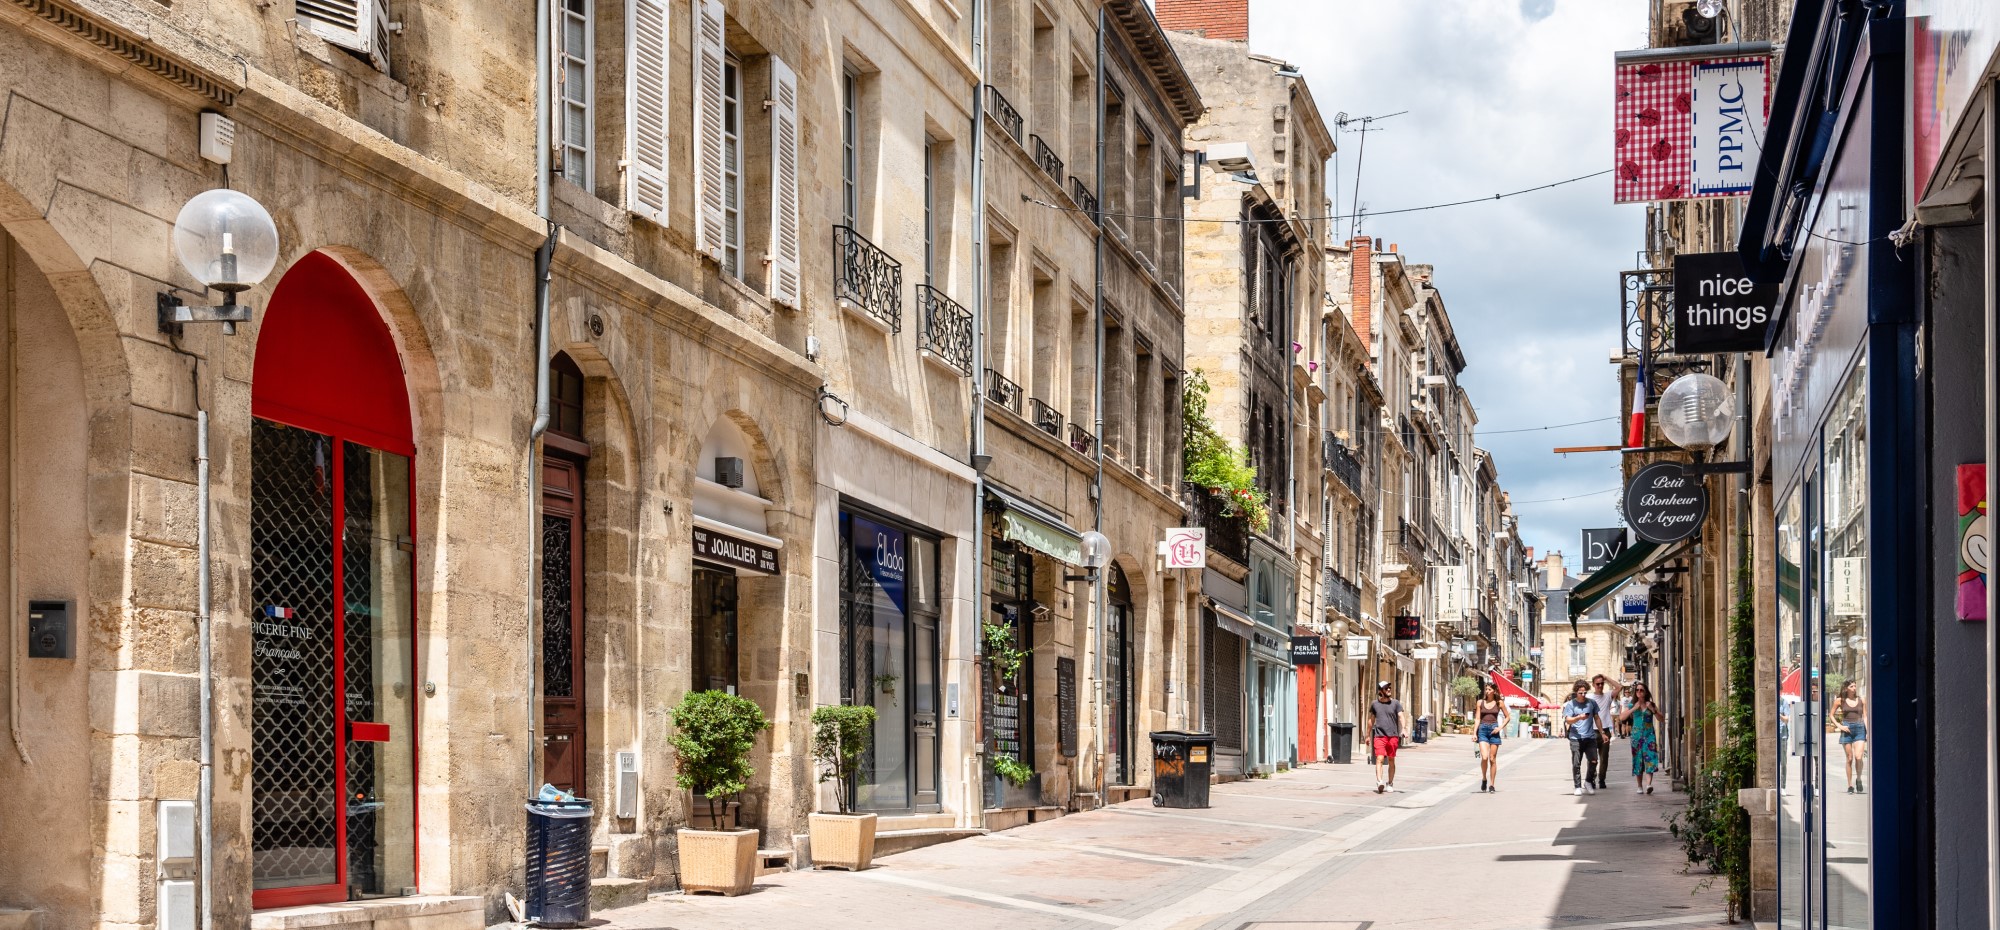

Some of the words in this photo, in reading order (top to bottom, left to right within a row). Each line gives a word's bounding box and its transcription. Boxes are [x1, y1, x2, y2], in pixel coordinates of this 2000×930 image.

[1718, 82, 1745, 173] PPMC
[1699, 273, 1754, 298] nice
[1687, 302, 1767, 333] things
[1652, 475, 1686, 489] Petit
[1640, 493, 1699, 507] Bonheur
[1638, 510, 1697, 527] d'Argent
[711, 538, 757, 565] JOAILLIER
[876, 532, 904, 572] Ellada
[1588, 532, 1622, 563] by
[251, 622, 288, 638] PICERIE
[290, 626, 313, 640] FINE
[254, 640, 302, 661] Française
